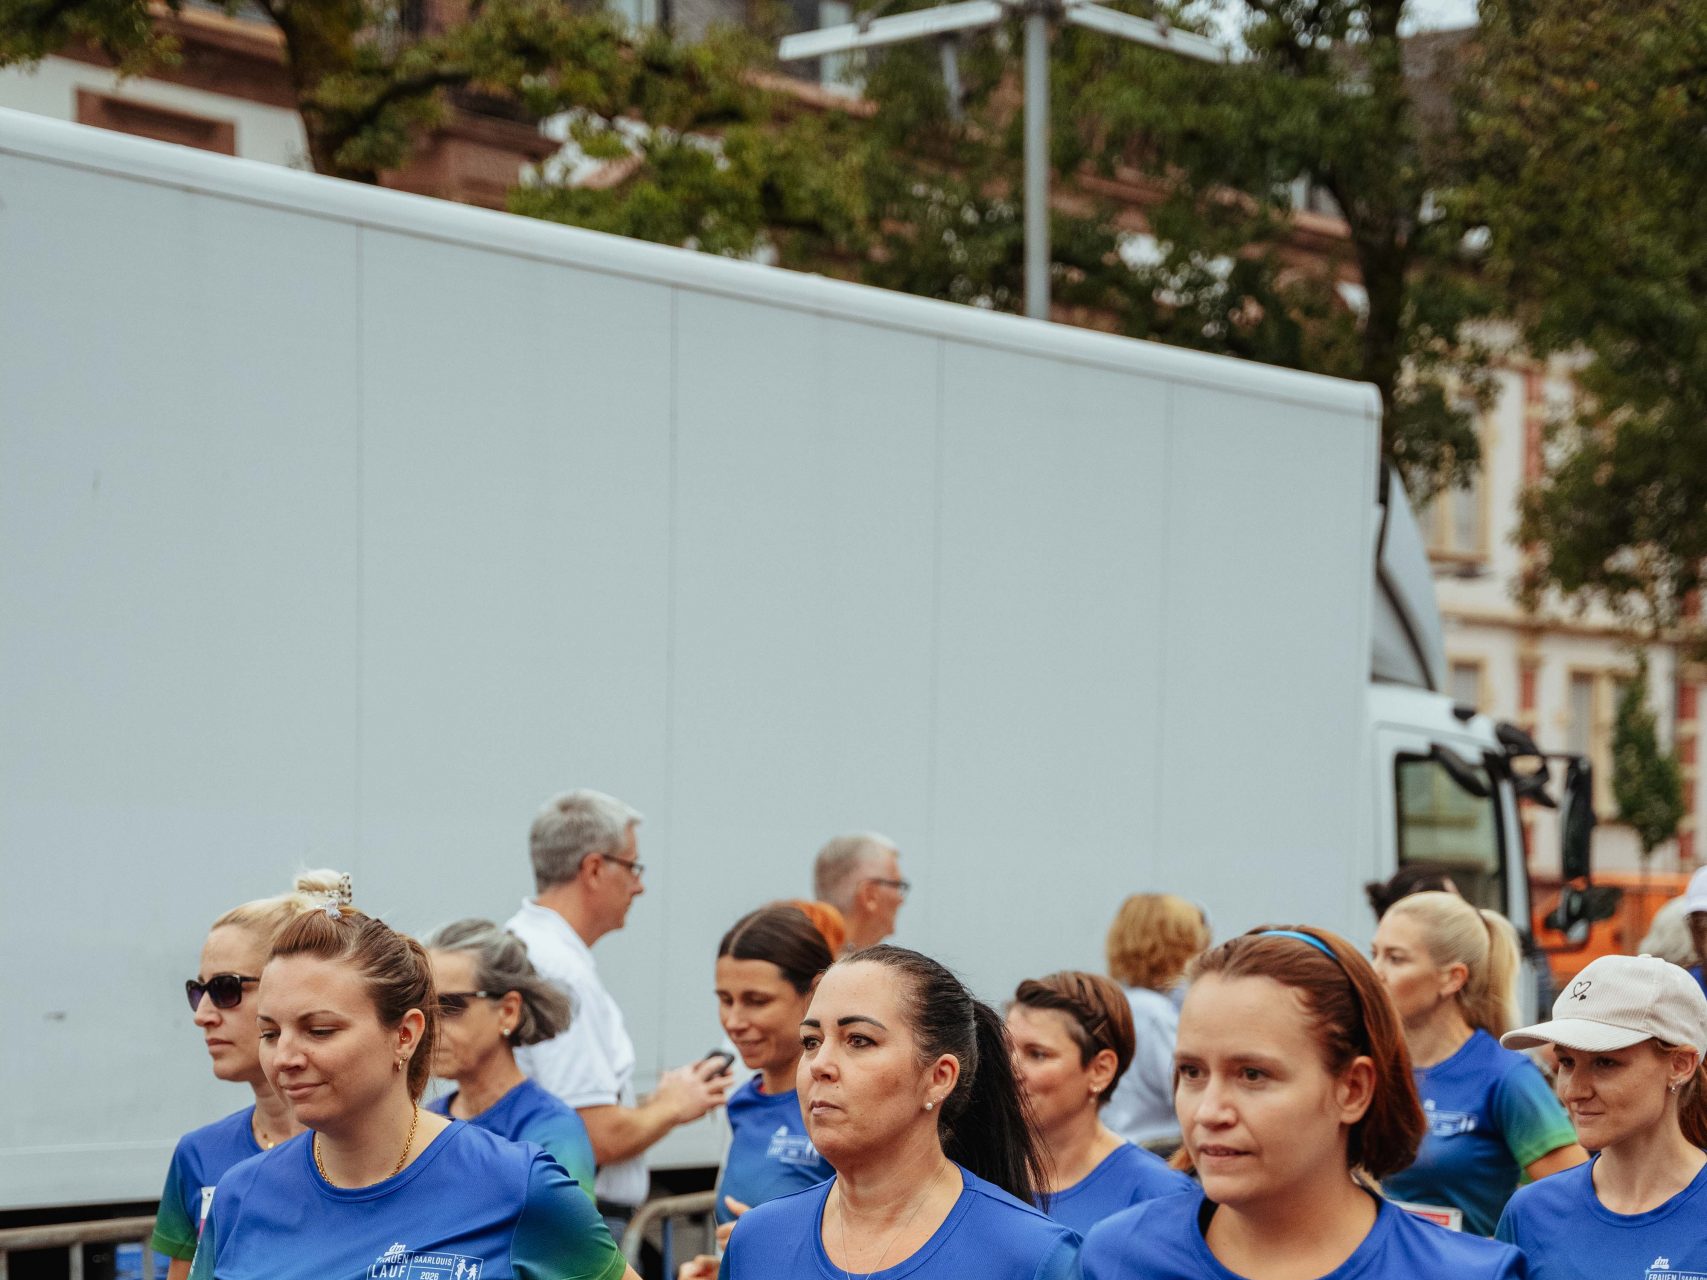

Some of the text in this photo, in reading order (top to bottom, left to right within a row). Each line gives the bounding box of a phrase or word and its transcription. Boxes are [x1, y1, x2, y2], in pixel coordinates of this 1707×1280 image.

[414, 1255, 453, 1266] SAARLOUIS
[371, 1264, 407, 1279] LAUF
[420, 1271, 440, 1280] 2026
